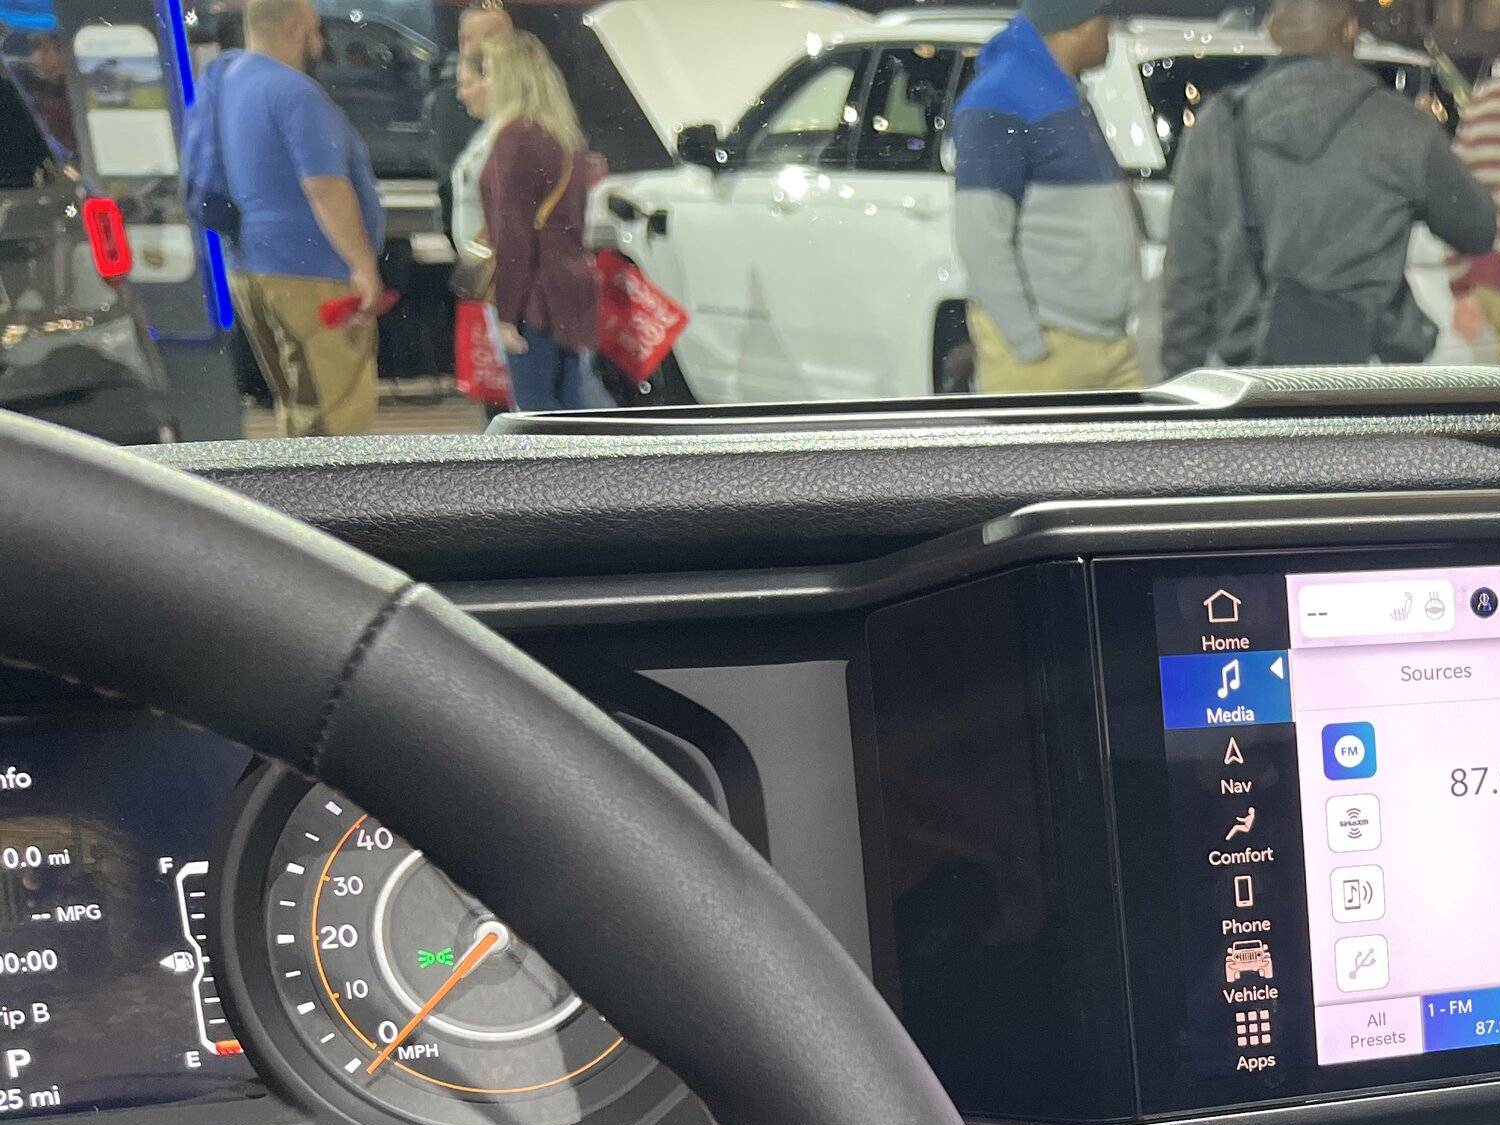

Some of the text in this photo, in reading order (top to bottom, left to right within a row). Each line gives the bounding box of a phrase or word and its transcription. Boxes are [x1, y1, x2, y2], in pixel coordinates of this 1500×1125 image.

[1202, 634, 1250, 651] Home
[1400, 663, 1473, 682] Sources
[1206, 705, 1255, 723] Media
[1340, 745, 1358, 758] FM
[1220, 778, 1252, 796] Nav
[356, 827, 393, 851] 40
[3, 846, 71, 869] 0.0 mi
[160, 857, 173, 873] F
[1208, 846, 1274, 866] Comfort
[333, 876, 364, 896] 30
[57, 904, 102, 922] MPG
[1222, 917, 1271, 935] Phone
[321, 926, 358, 948] 20
[0, 949, 57, 974] 0:00
[345, 979, 368, 998] 10
[1223, 984, 1279, 1004] Vehicle
[32, 1003, 50, 1022] B
[1428, 1003, 1435, 1017] 1
[1450, 1000, 1473, 1015] FM
[1367, 1012, 1386, 1028] All
[378, 1020, 398, 1043] 0
[1350, 1029, 1406, 1049] Presets
[186, 1050, 200, 1068] E
[398, 1042, 439, 1061] MPH
[7, 1049, 31, 1077] P
[1236, 1054, 1276, 1072] Apps
[30, 1085, 60, 1107] mi
